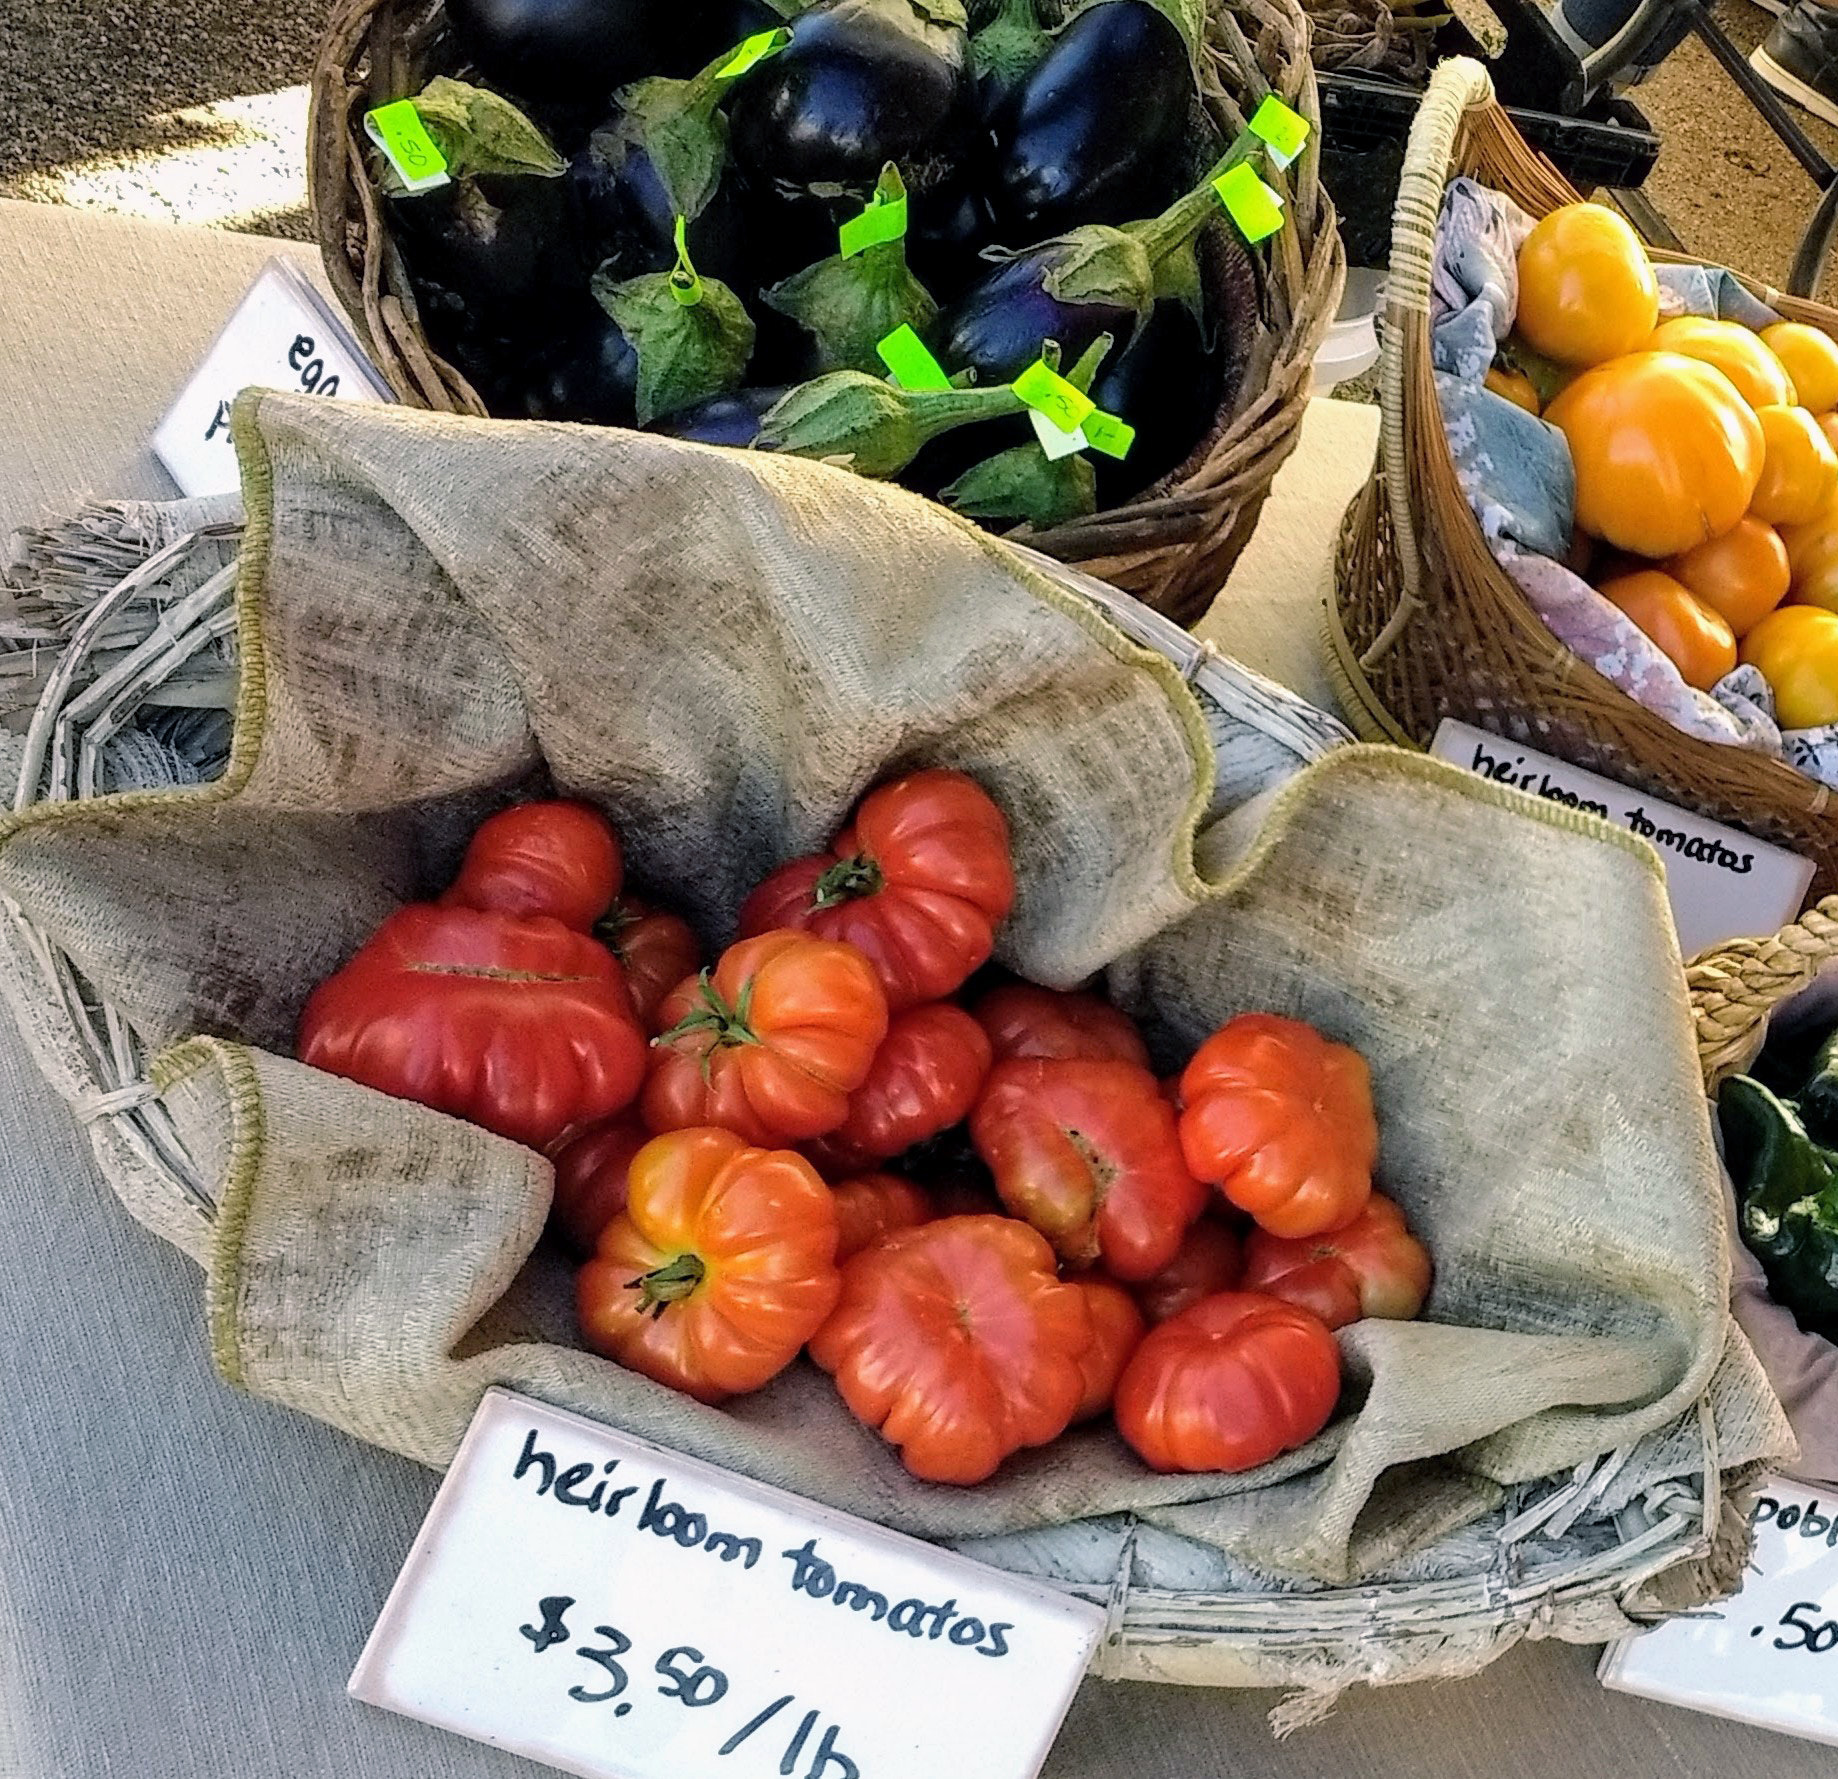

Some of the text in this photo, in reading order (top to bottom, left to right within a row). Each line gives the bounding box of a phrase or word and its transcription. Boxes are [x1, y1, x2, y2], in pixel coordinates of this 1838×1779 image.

[1471, 742, 1755, 874] heirloom tomatos
[513, 1430, 1016, 1658] heirloom tomatos
